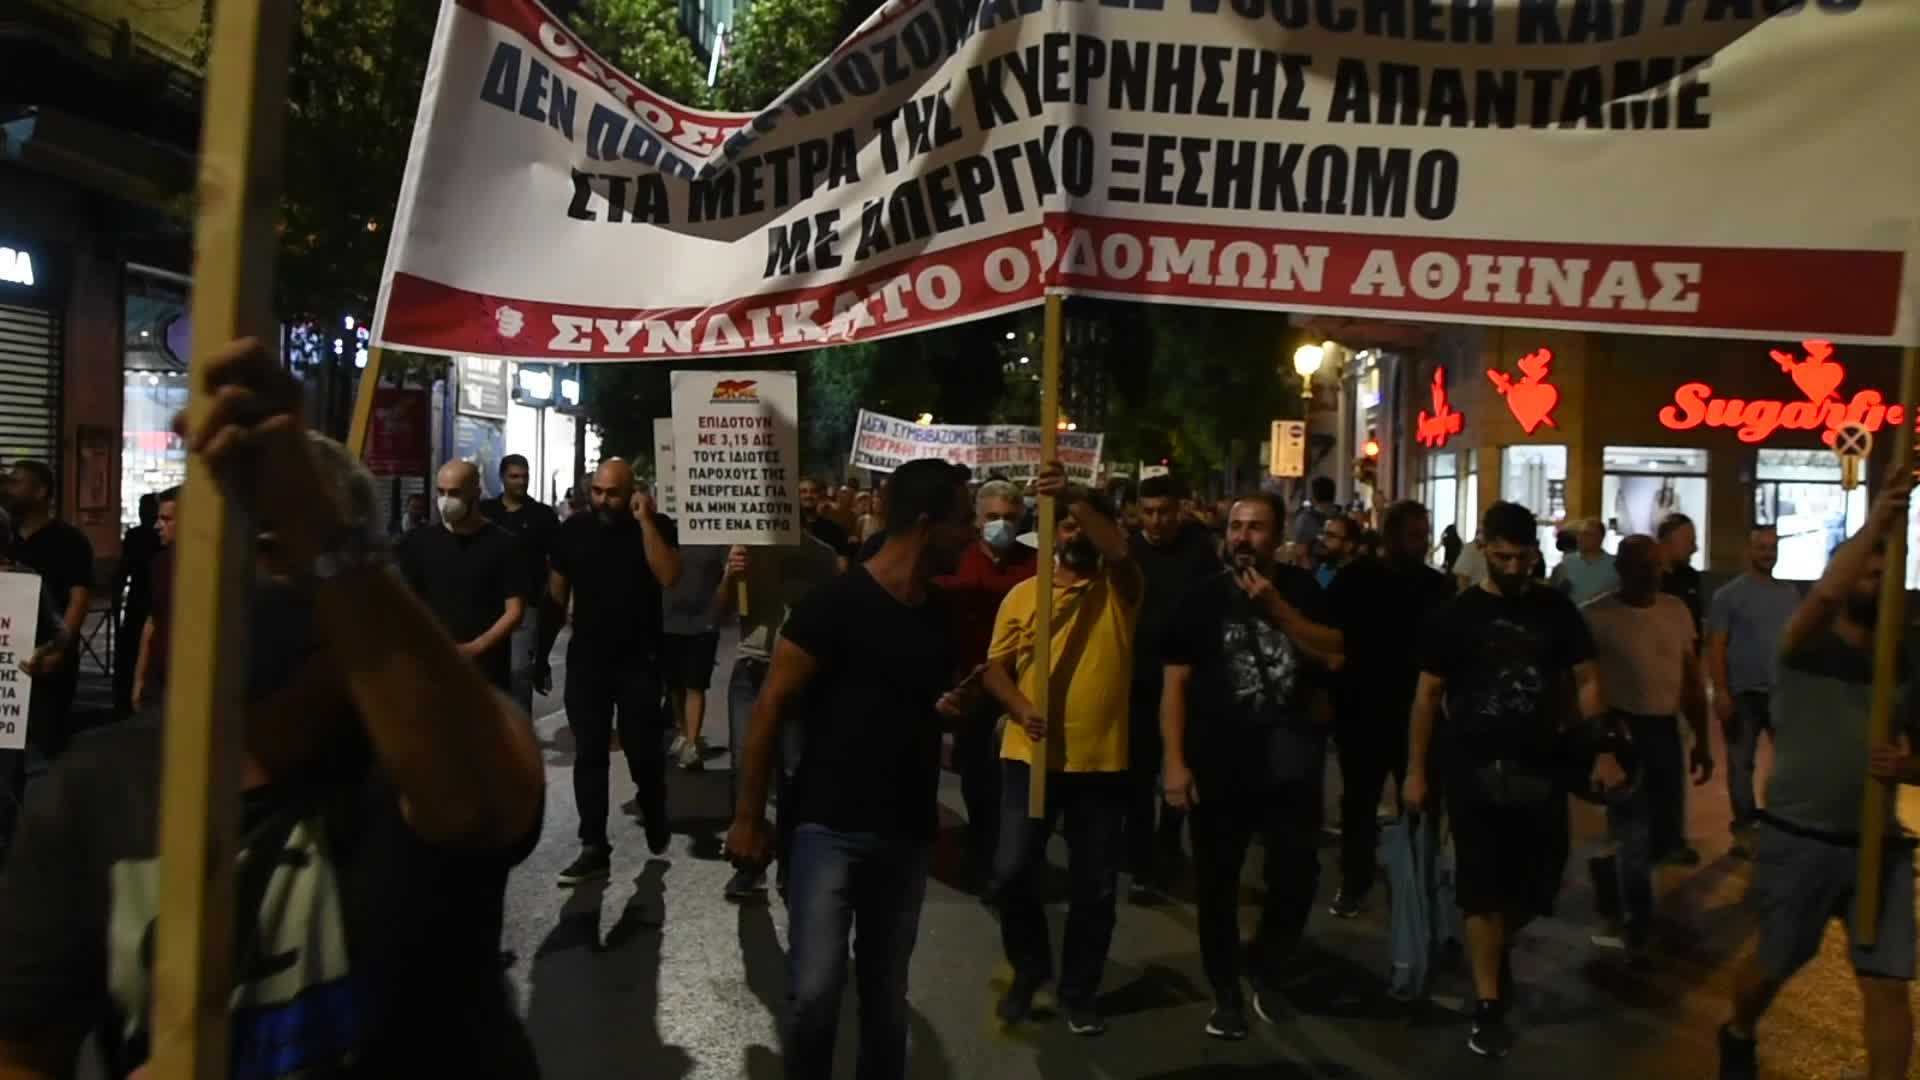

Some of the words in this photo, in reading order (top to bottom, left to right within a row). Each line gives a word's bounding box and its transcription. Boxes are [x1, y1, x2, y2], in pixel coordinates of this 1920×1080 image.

[480, 41, 577, 141] ΔΕΝ
[566, 168, 670, 224] ΣΤΑ
[687, 130, 860, 224] ΜΕΤΡΑ
[873, 81, 962, 175] ΤΗΣ
[967, 32, 1312, 131] ΚΥΕΡΝΗΣΗΣ
[1328, 56, 1713, 131] ΑΠΑΝΤΑΜΕ
[763, 217, 842, 280] ΜΕ
[1109, 131, 1460, 221] ΞΕΣΗΚΩΜΟ
[548, 263, 963, 354] ΣΥΝΔΙΚΑΤΟ
[1351, 247, 1703, 315] ΑΘΗΝΑΣ
[698, 416, 773, 429] ΕΠΙΔΟΤΟΥΝ
[698, 433, 716, 446] ΜΕ
[721, 433, 749, 448] 3,15
[753, 433, 777, 446] ΔΙΣ
[693, 451, 727, 463] ΤΟΥΣ
[729, 451, 781, 463] ΙΔΙΩΤΕΣ
[688, 467, 759, 480] ΠΑΡΟΧΟΥΣ
[761, 467, 785, 480] ΤΗΣ
[690, 484, 761, 497] ΕΝΕΡΓΕΙΑΣ
[765, 484, 787, 497] ΓΙΑ
[685, 501, 704, 514] ΝΑ
[707, 501, 737, 514] ΜΗΝ
[740, 501, 793, 515] ΧΑΣΟΥΝ
[689, 518, 723, 531] ΟΥΤΕ
[725, 518, 753, 531] ΕΝΑ
[756, 518, 791, 532] ΕΥΡΩ
